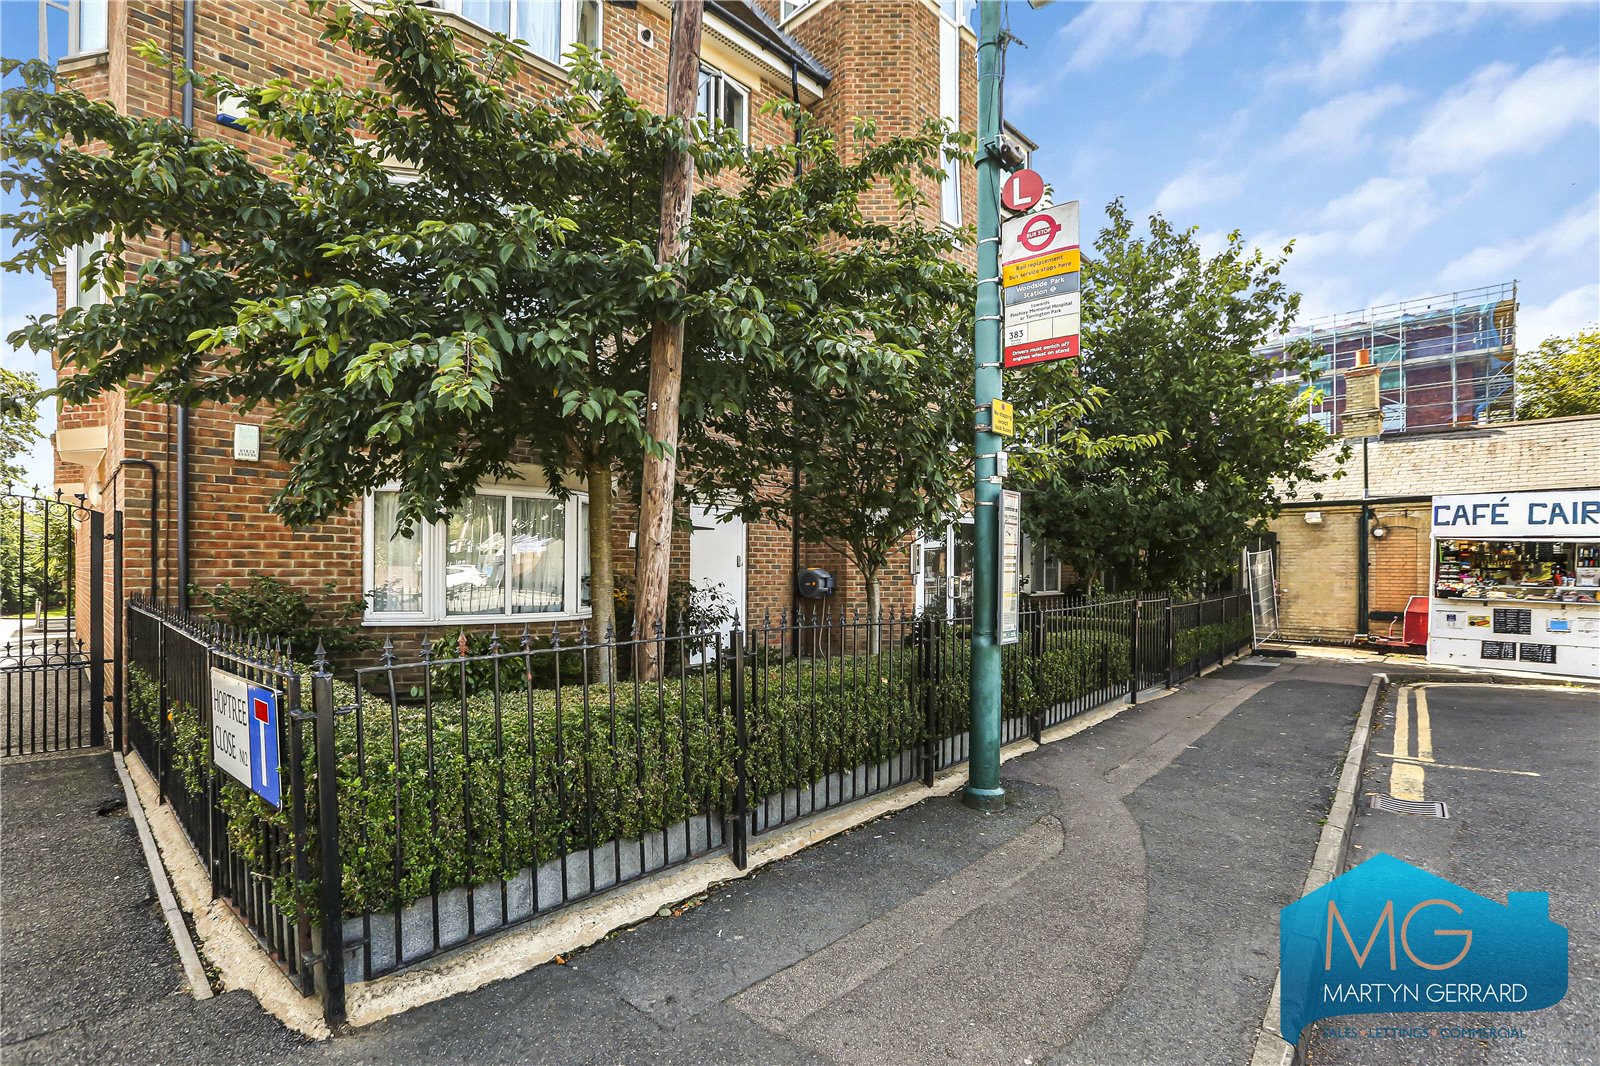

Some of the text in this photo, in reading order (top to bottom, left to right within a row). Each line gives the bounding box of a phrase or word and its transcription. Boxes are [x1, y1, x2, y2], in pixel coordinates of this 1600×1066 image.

[1013, 178, 1031, 206] L
[1026, 227, 1051, 238] BUS STOP
[1028, 256, 1064, 268] replacement
[1016, 276, 1065, 292] Woodside Park
[1024, 289, 1048, 298] Station
[1026, 311, 1050, 319] Torrington
[1009, 330, 1024, 339] 383
[1434, 496, 1600, 526] CAFÉ CAIR
[213, 688, 247, 727] HOPTREE
[215, 725, 248, 766] CLOSE N12
